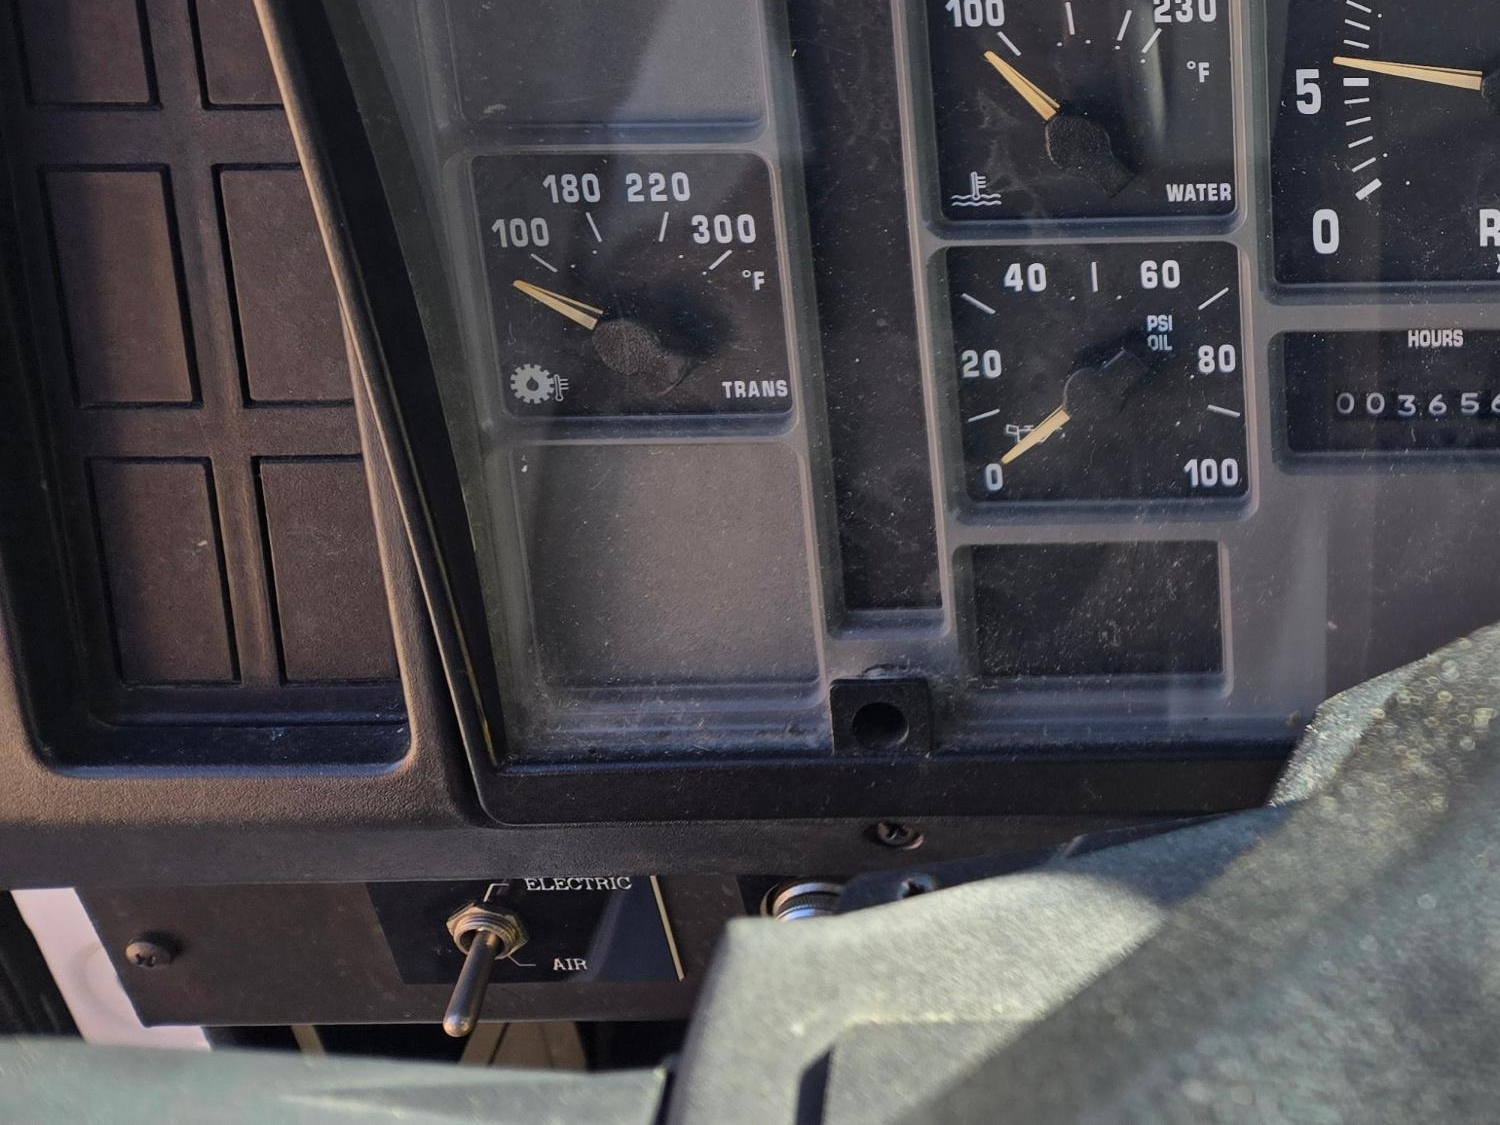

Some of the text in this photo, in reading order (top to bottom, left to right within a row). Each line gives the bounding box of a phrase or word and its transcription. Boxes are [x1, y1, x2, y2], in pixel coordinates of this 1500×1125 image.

[1295, 69, 1321, 115] 5
[543, 173, 600, 203] 180
[625, 172, 690, 202] 220
[1166, 183, 1232, 202] WATER
[491, 217, 550, 248] 100
[691, 214, 756, 244] 300
[1312, 209, 1340, 254] 0
[1004, 263, 1047, 292] 40
[1140, 260, 1180, 289] 60
[1146, 315, 1173, 332] PSI
[1147, 335, 1173, 351] OIL
[1408, 329, 1464, 348] HOURS
[961, 350, 1002, 378] 20
[1198, 344, 1236, 373] 80
[722, 380, 788, 399] TRANS
[985, 463, 1003, 491] 0
[1183, 458, 1239, 487] 100
[524, 876, 633, 891] ELECTRIC
[553, 958, 588, 971] AIR
